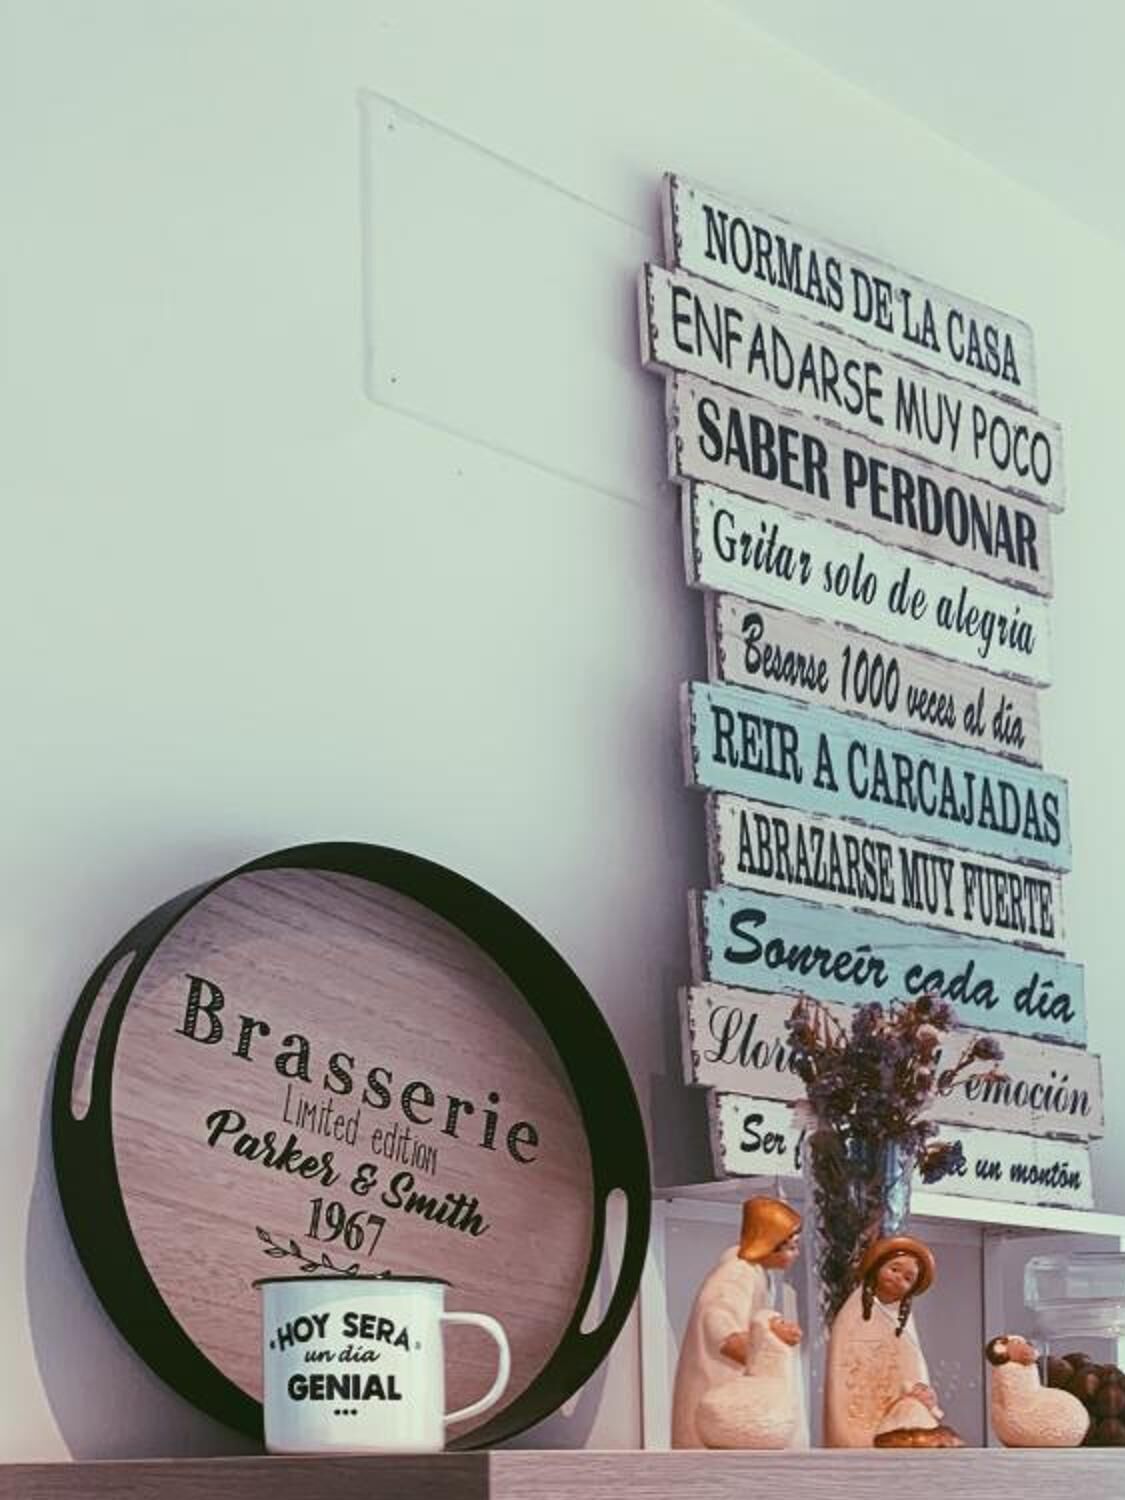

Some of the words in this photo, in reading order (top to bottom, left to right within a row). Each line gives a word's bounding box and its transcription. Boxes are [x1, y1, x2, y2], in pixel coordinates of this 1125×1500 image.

[702, 204, 844, 313] NORMAS
[850, 267, 895, 331] DE
[899, 286, 941, 353] LA
[946, 307, 1022, 386] CASA
[671, 284, 885, 427] ENFADARSE
[895, 377, 963, 452] MUY
[972, 403, 1053, 486] POCO
[698, 397, 830, 500] SABER
[843, 448, 1040, 573] PERDONAR
[713, 509, 813, 585] Gritar
[823, 551, 878, 606] solo
[888, 567, 928, 620] de
[741, 611, 829, 694] Besarse
[841, 644, 900, 714] 1000
[906, 684, 957, 730] veces
[963, 687, 987, 737] al
[992, 695, 1026, 749] día
[710, 704, 803, 785] REIR
[813, 732, 840, 793] A
[847, 740, 1063, 848] CARCAJADAS
[737, 808, 896, 903] ABRAZARSE
[898, 845, 956, 917] MUY
[961, 859, 1056, 938] FUERTE
[724, 907, 889, 988] Sonreír
[903, 958, 1002, 1006] cada
[1012, 970, 1077, 1025] día
[175, 973, 540, 1164] Brasserie
[965, 1070, 1093, 1118] emoción
[206, 1109, 341, 1188] Parker
[351, 1163, 379, 1196] &
[381, 1171, 491, 1237] Smith
[283, 1083, 361, 1147] Limited
[371, 1121, 438, 1176] edition
[740, 1113, 787, 1155] Ser
[975, 1154, 1003, 1182] un
[1009, 1160, 1082, 1191] montón
[303, 1197, 386, 1257] 1967
[275, 1312, 330, 1351] HOY
[342, 1311, 410, 1352] SERA
[287, 1373, 402, 1401] GENIAL
[304, 1349, 336, 1363] un
[338, 1344, 381, 1363] día
